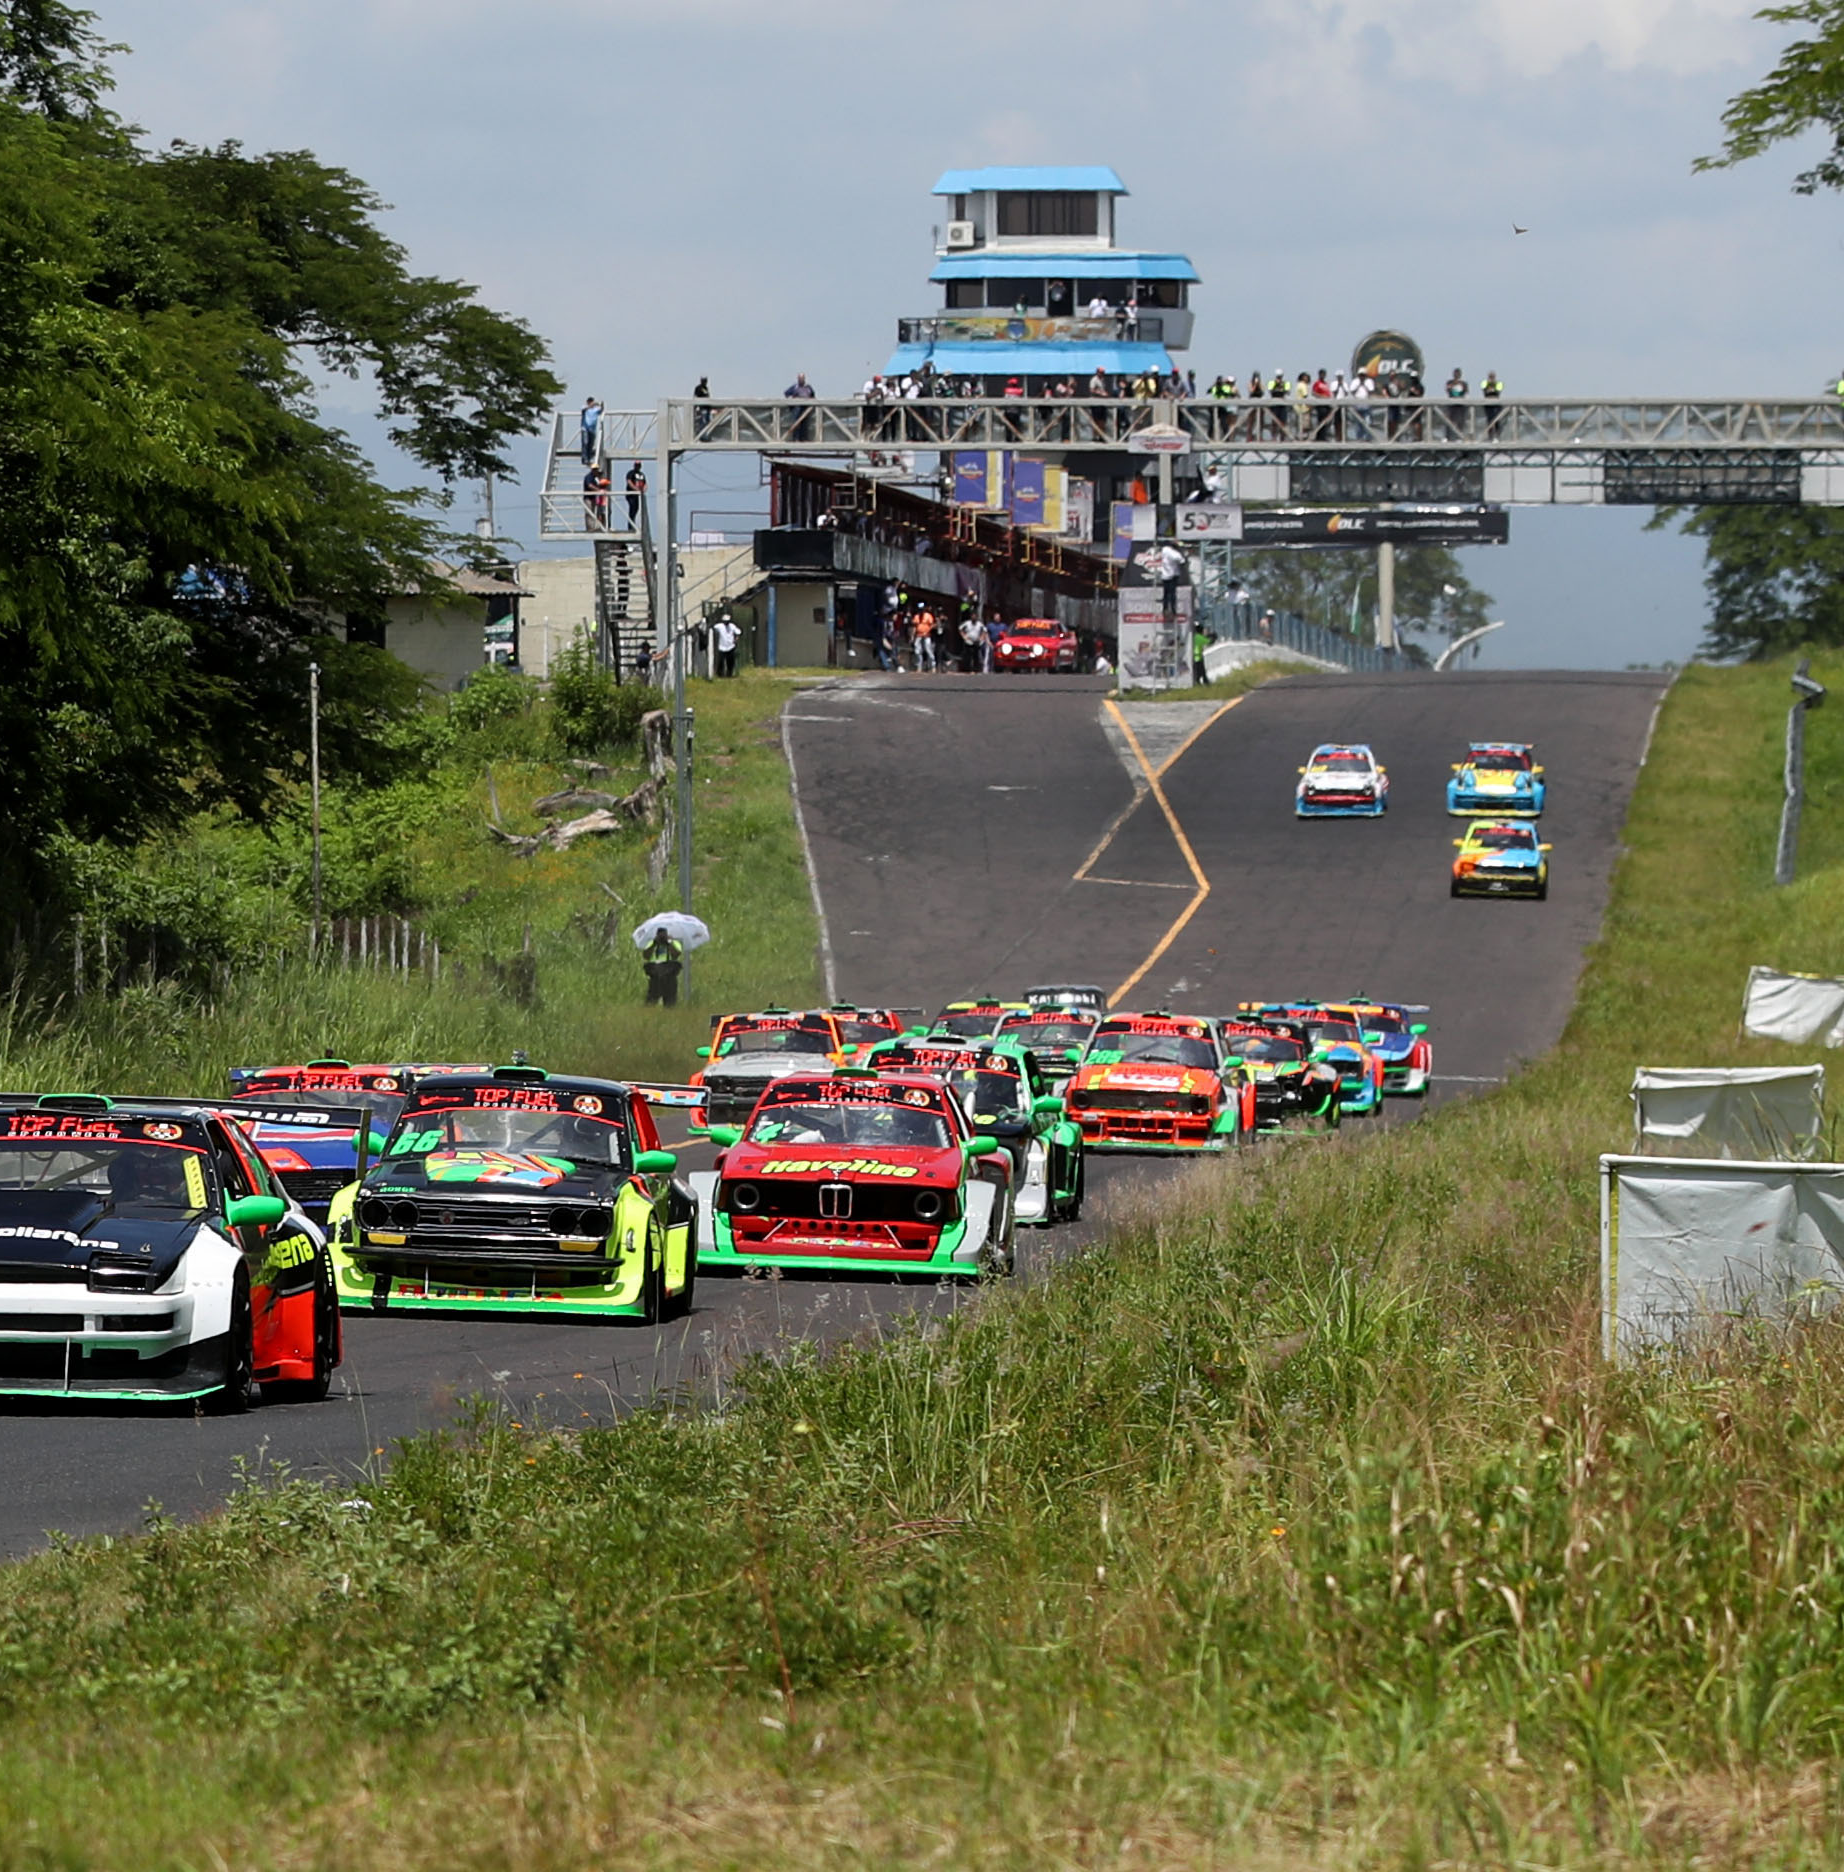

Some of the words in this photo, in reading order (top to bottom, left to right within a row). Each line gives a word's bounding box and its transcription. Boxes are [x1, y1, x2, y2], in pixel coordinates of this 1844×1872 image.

[1084, 1050, 1125, 1064] 285
[322, 1074, 364, 1087] FUEL
[474, 1089, 509, 1105] TOP
[512, 1090, 559, 1107] FUEL
[9, 1117, 56, 1132] TOP
[59, 1117, 123, 1134] FUEL
[389, 1130, 445, 1156] 66
[760, 1158, 919, 1178] Havoline
